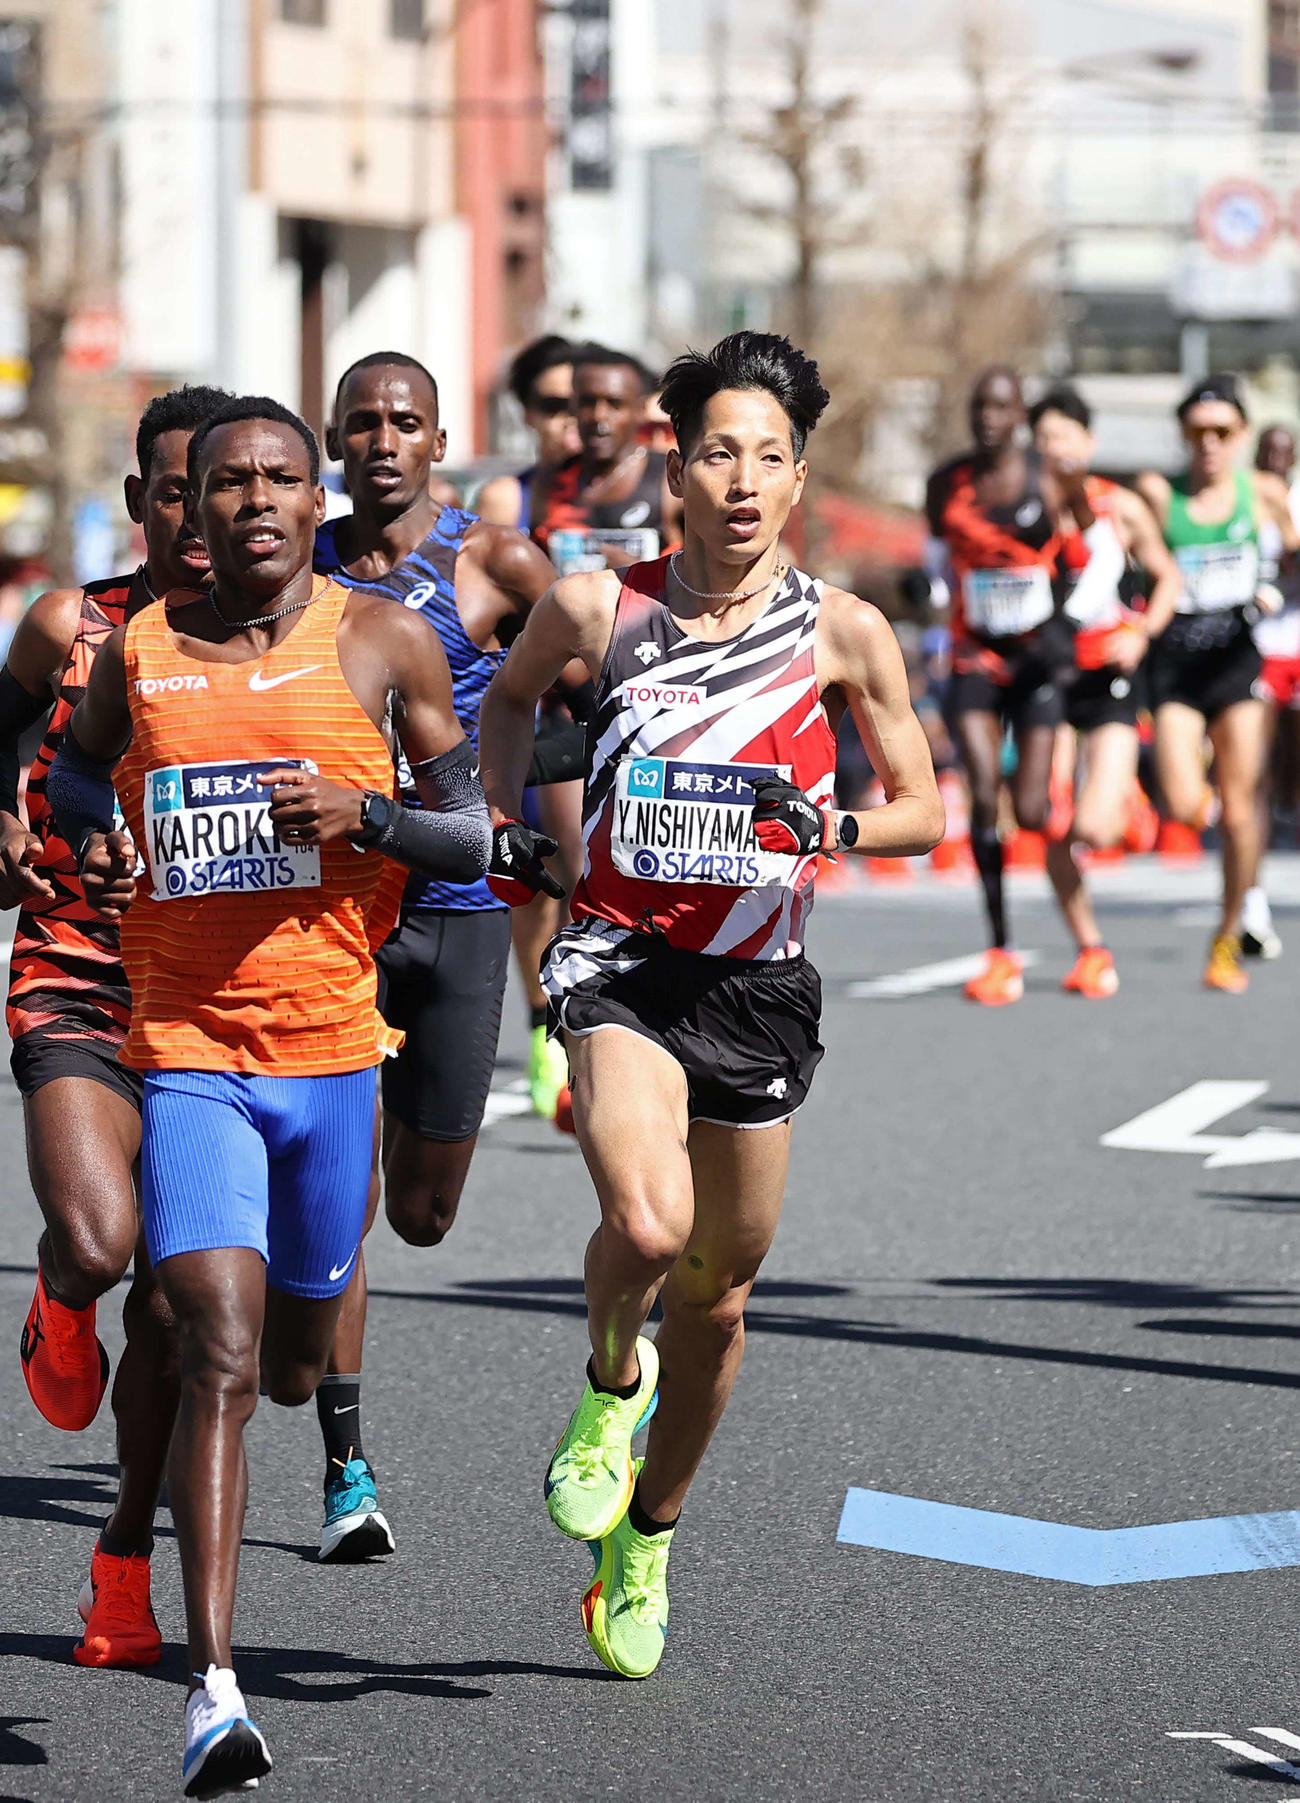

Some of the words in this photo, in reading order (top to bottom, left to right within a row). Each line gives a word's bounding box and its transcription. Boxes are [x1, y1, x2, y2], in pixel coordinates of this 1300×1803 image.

[134, 675, 209, 695] TOYOTA
[626, 687, 700, 705] TOYOTA
[189, 772, 294, 799] 東京メト
[672, 771, 757, 796] 東京メト
[618, 799, 758, 854] Y.NISHIYAMA
[190, 856, 296, 892] STARTS
[661, 851, 760, 885] STARTS
